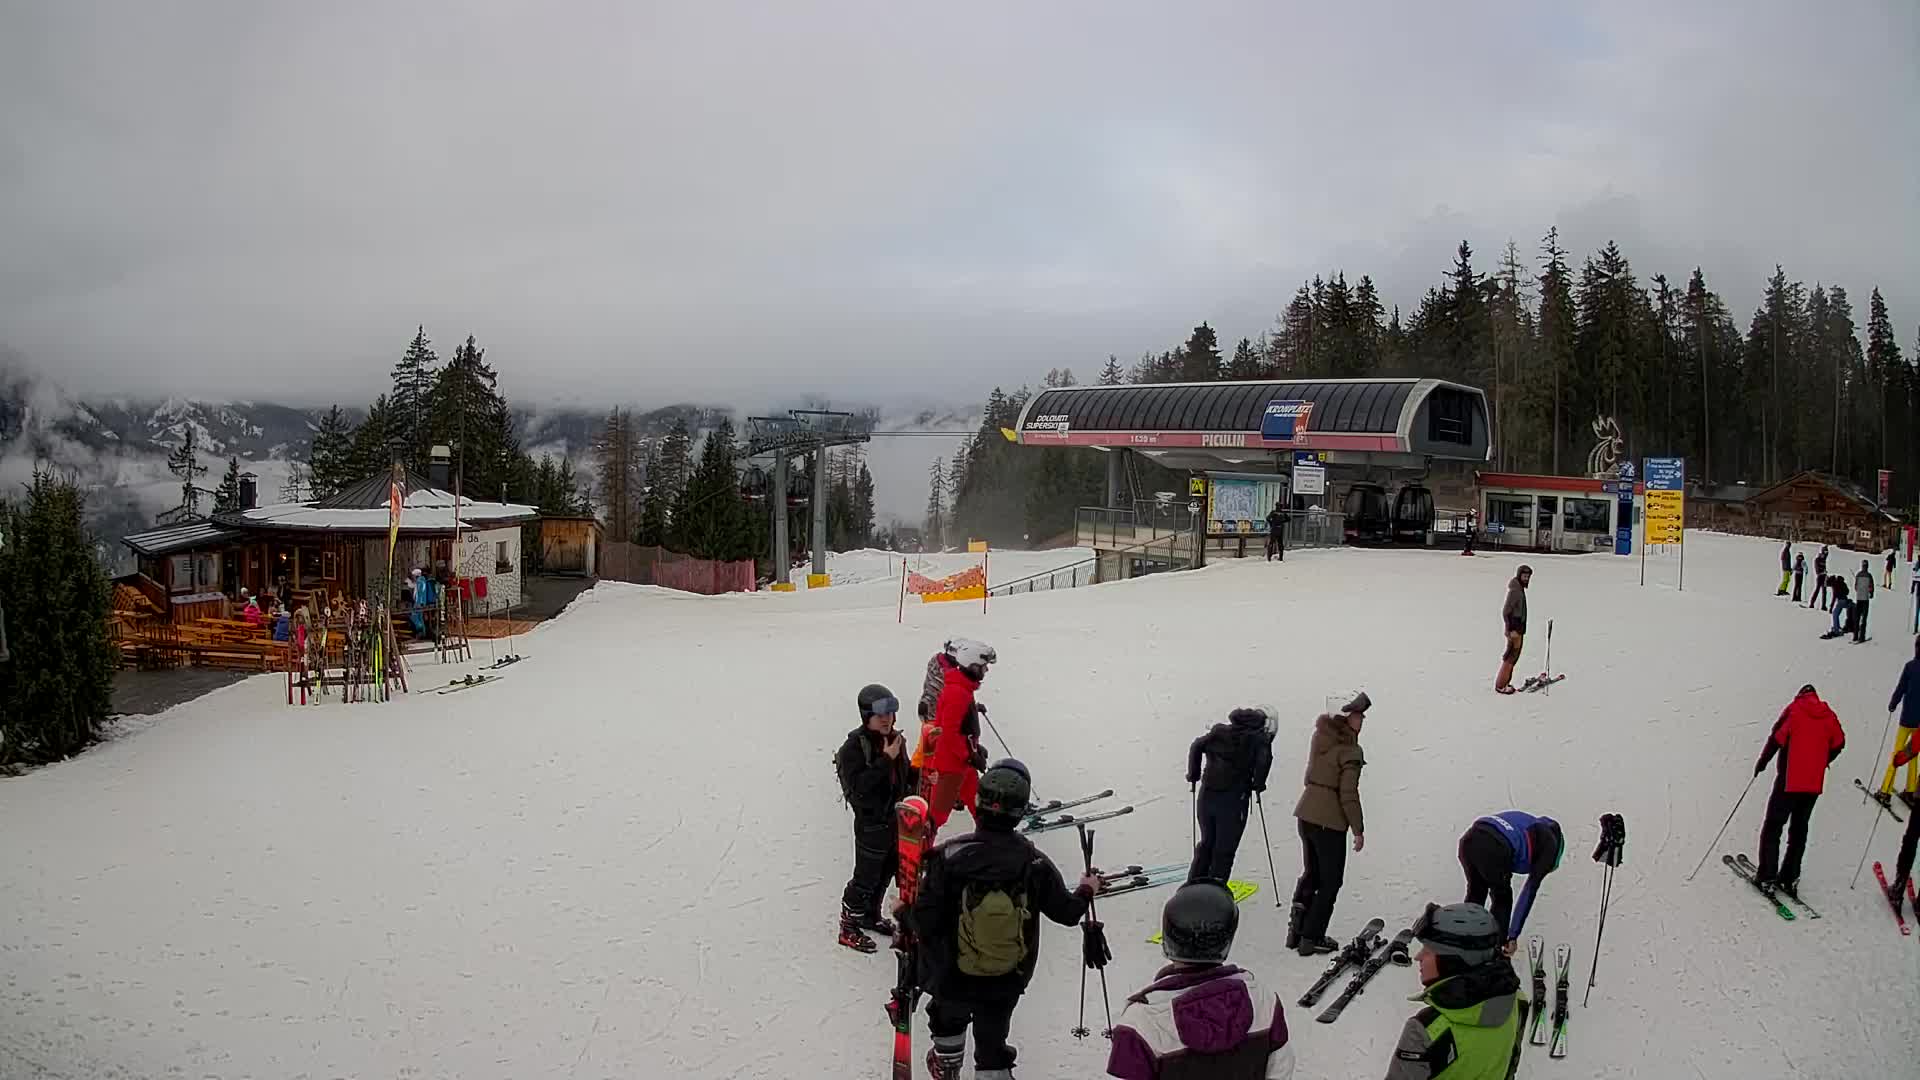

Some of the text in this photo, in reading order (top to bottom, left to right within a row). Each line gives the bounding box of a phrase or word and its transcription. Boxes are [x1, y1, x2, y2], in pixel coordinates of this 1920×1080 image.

[1266, 405, 1312, 413] KRONPLATZ
[1036, 414, 1068, 422] DOLOMITI
[1026, 422, 1058, 430] SUPERSKI
[1202, 434, 1245, 447] PICULIN
[467, 533, 479, 543] da
